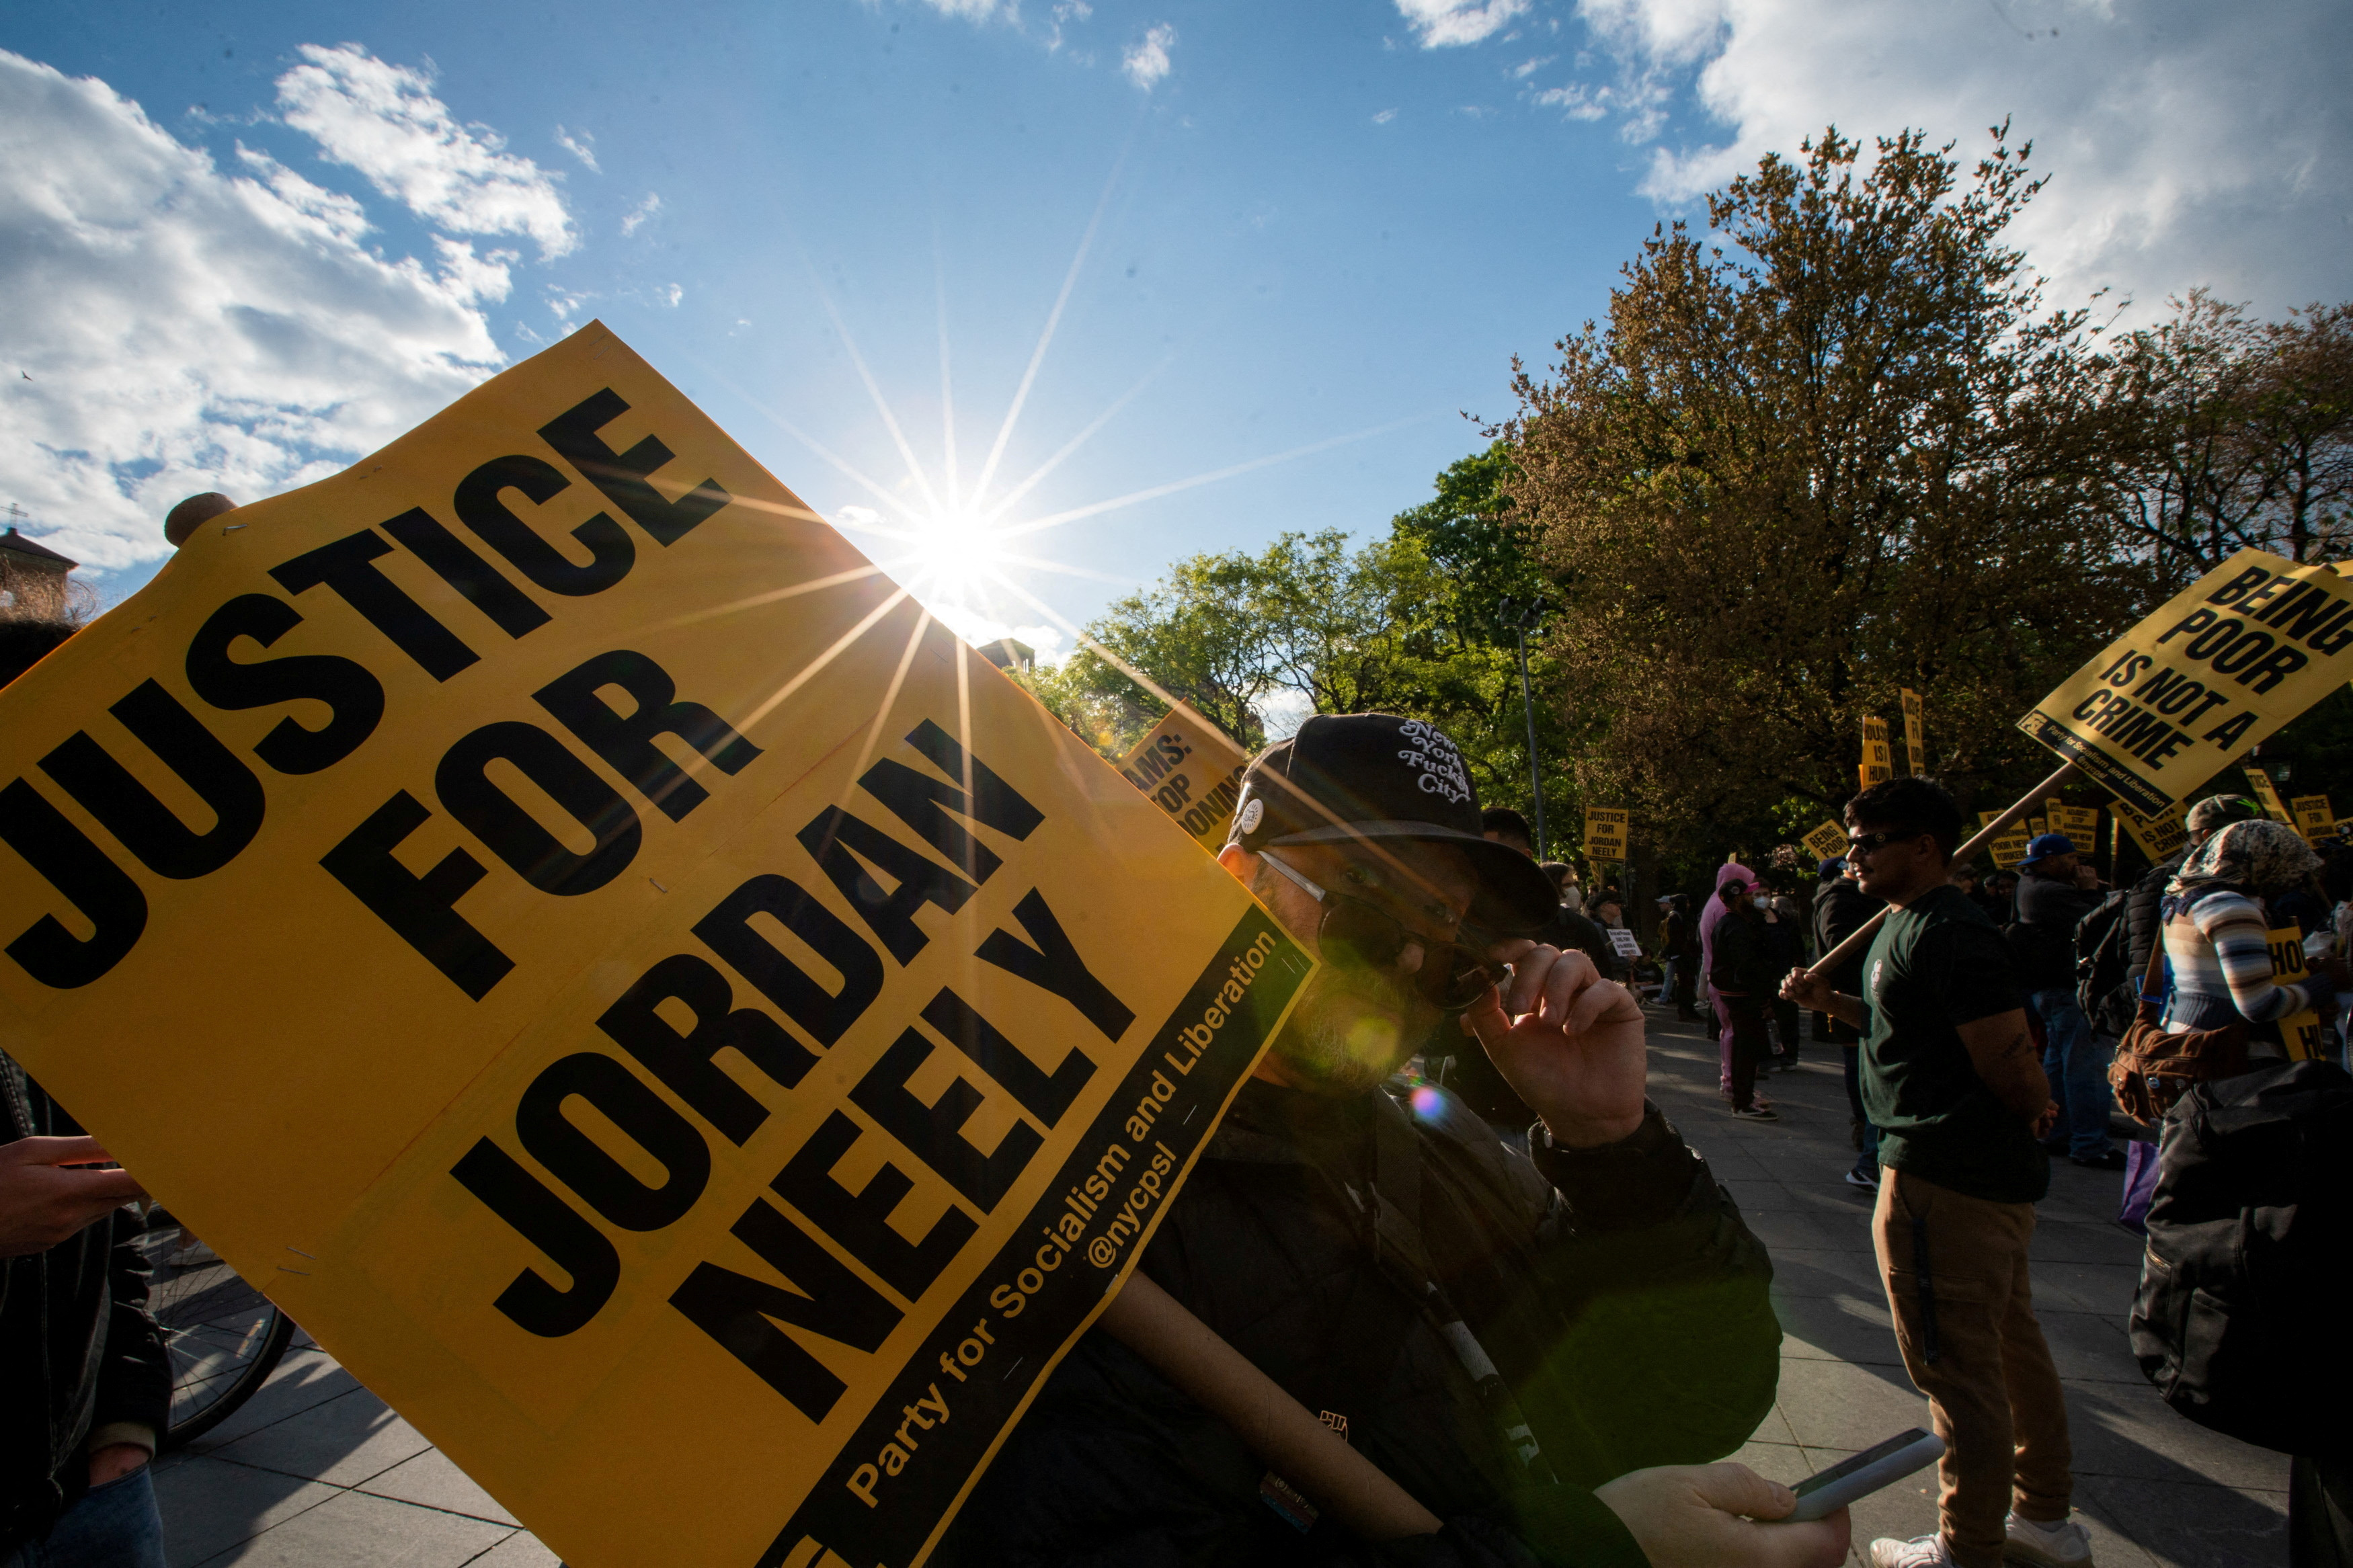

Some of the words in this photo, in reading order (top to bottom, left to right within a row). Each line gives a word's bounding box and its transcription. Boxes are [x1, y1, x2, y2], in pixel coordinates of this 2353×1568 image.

[2204, 565, 2353, 656] BEING
[2156, 608, 2309, 696] POOR
[0, 386, 732, 989] JUSTICE
[2099, 649, 2152, 688] IS
[2131, 667, 2230, 727] NOT
[2202, 710, 2260, 752] A
[1398, 719, 1459, 751] New
[2072, 688, 2195, 771] CRIME
[1417, 773, 1471, 804] City
[2047, 725, 2067, 741] Party
[2064, 735, 2076, 746] for
[2071, 740, 2109, 770] Socialism
[2108, 764, 2126, 780] and
[2123, 775, 2166, 809] Liberation
[318, 649, 764, 1002] FOR
[1588, 811, 1626, 823] JUSTICE
[1597, 823, 1615, 835] FOR
[2141, 830, 2157, 843] IS
[2154, 819, 2182, 838] NOT
[2296, 798, 2327, 812] JUSTICE
[1589, 836, 1622, 848] JORDAN
[1592, 846, 1618, 857] NEELY
[1808, 825, 1839, 849] BEING
[1819, 836, 1848, 858] POOR
[1990, 840, 2012, 852] POOR
[450, 719, 1046, 1338] JORDAN
[667, 887, 1137, 1426] NEELY
[846, 1382, 951, 1508] Party
[939, 1317, 996, 1383] for
[989, 1143, 1132, 1319] Socialism
[1125, 1069, 1177, 1142] and
[1164, 930, 1277, 1077] Liberation
[1088, 1141, 1176, 1269] @nycpsl
